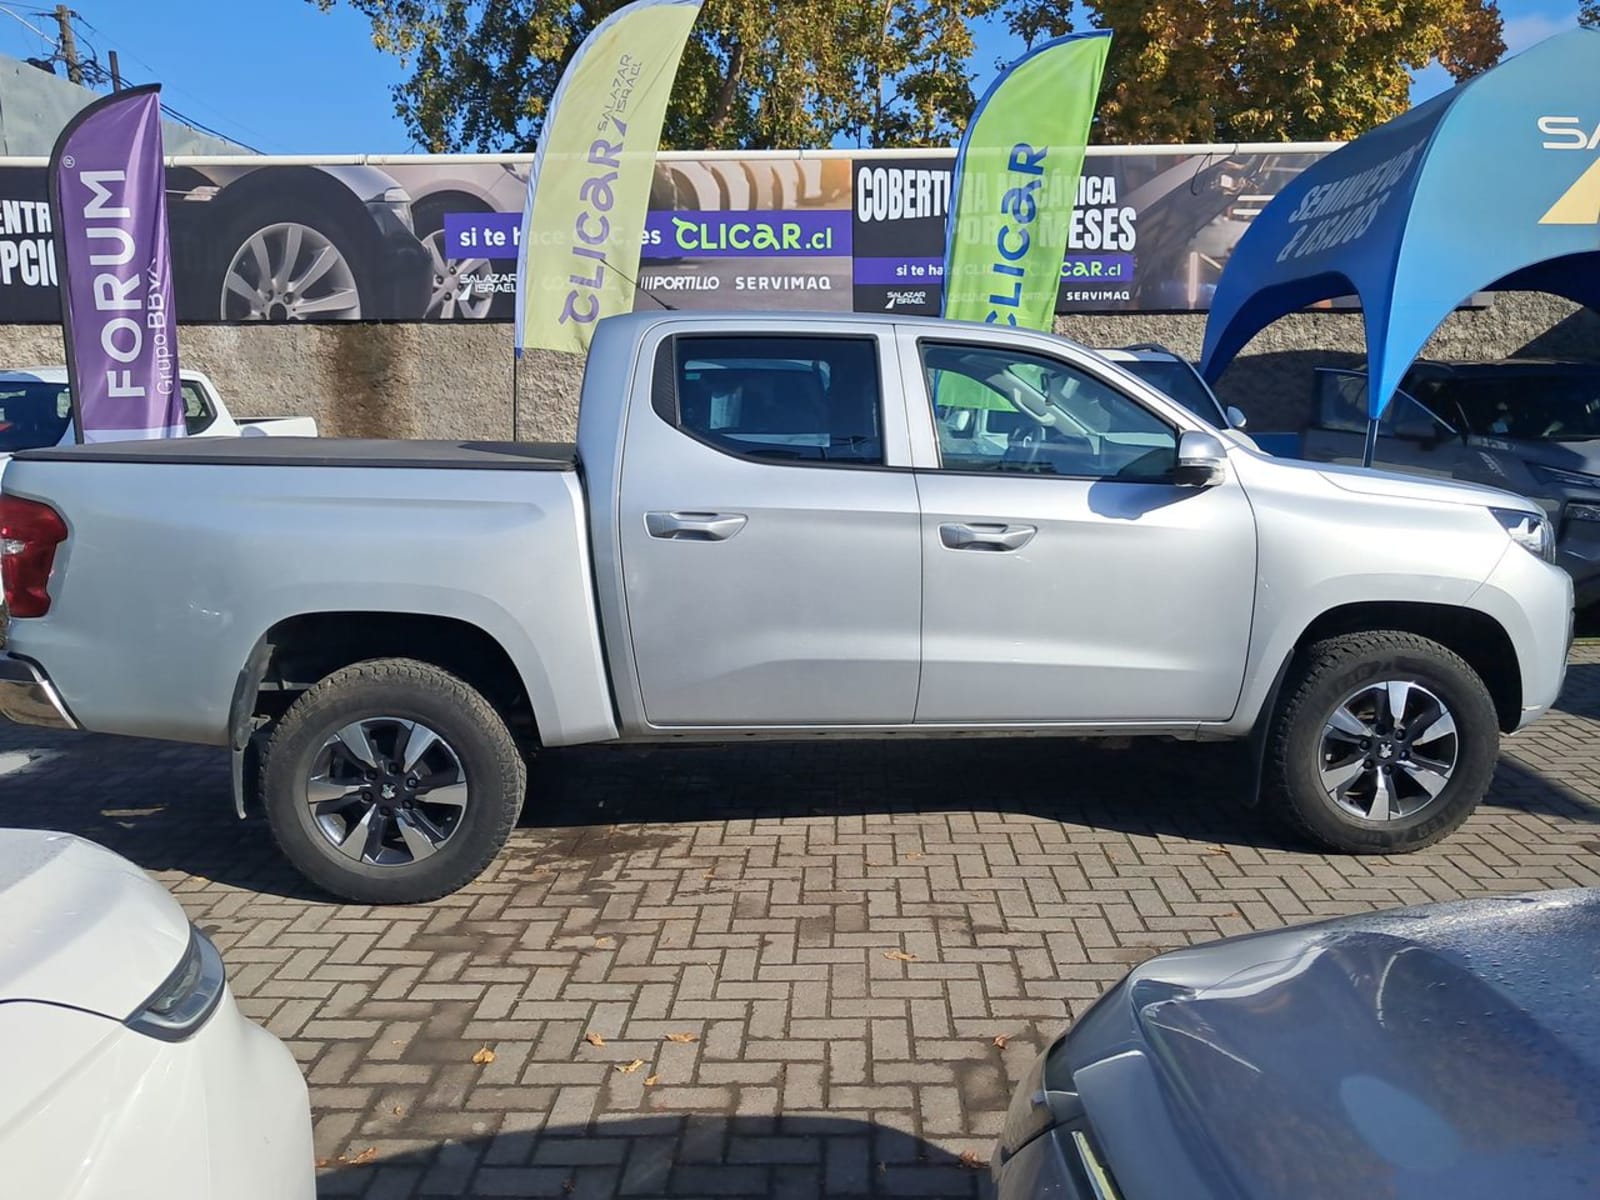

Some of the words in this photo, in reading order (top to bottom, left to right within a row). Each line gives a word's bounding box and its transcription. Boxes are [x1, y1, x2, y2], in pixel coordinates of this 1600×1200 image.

[459, 227, 478, 246] si
[484, 228, 506, 246] te
[896, 265, 907, 275] si
[911, 265, 924, 275] te
[79, 170, 146, 397] FORUM
[653, 276, 720, 290] PORTILLO
[735, 276, 831, 290] SERVIMAQ
[1066, 291, 1130, 301] SERVIMAQ
[154, 334, 173, 395] Grupo
